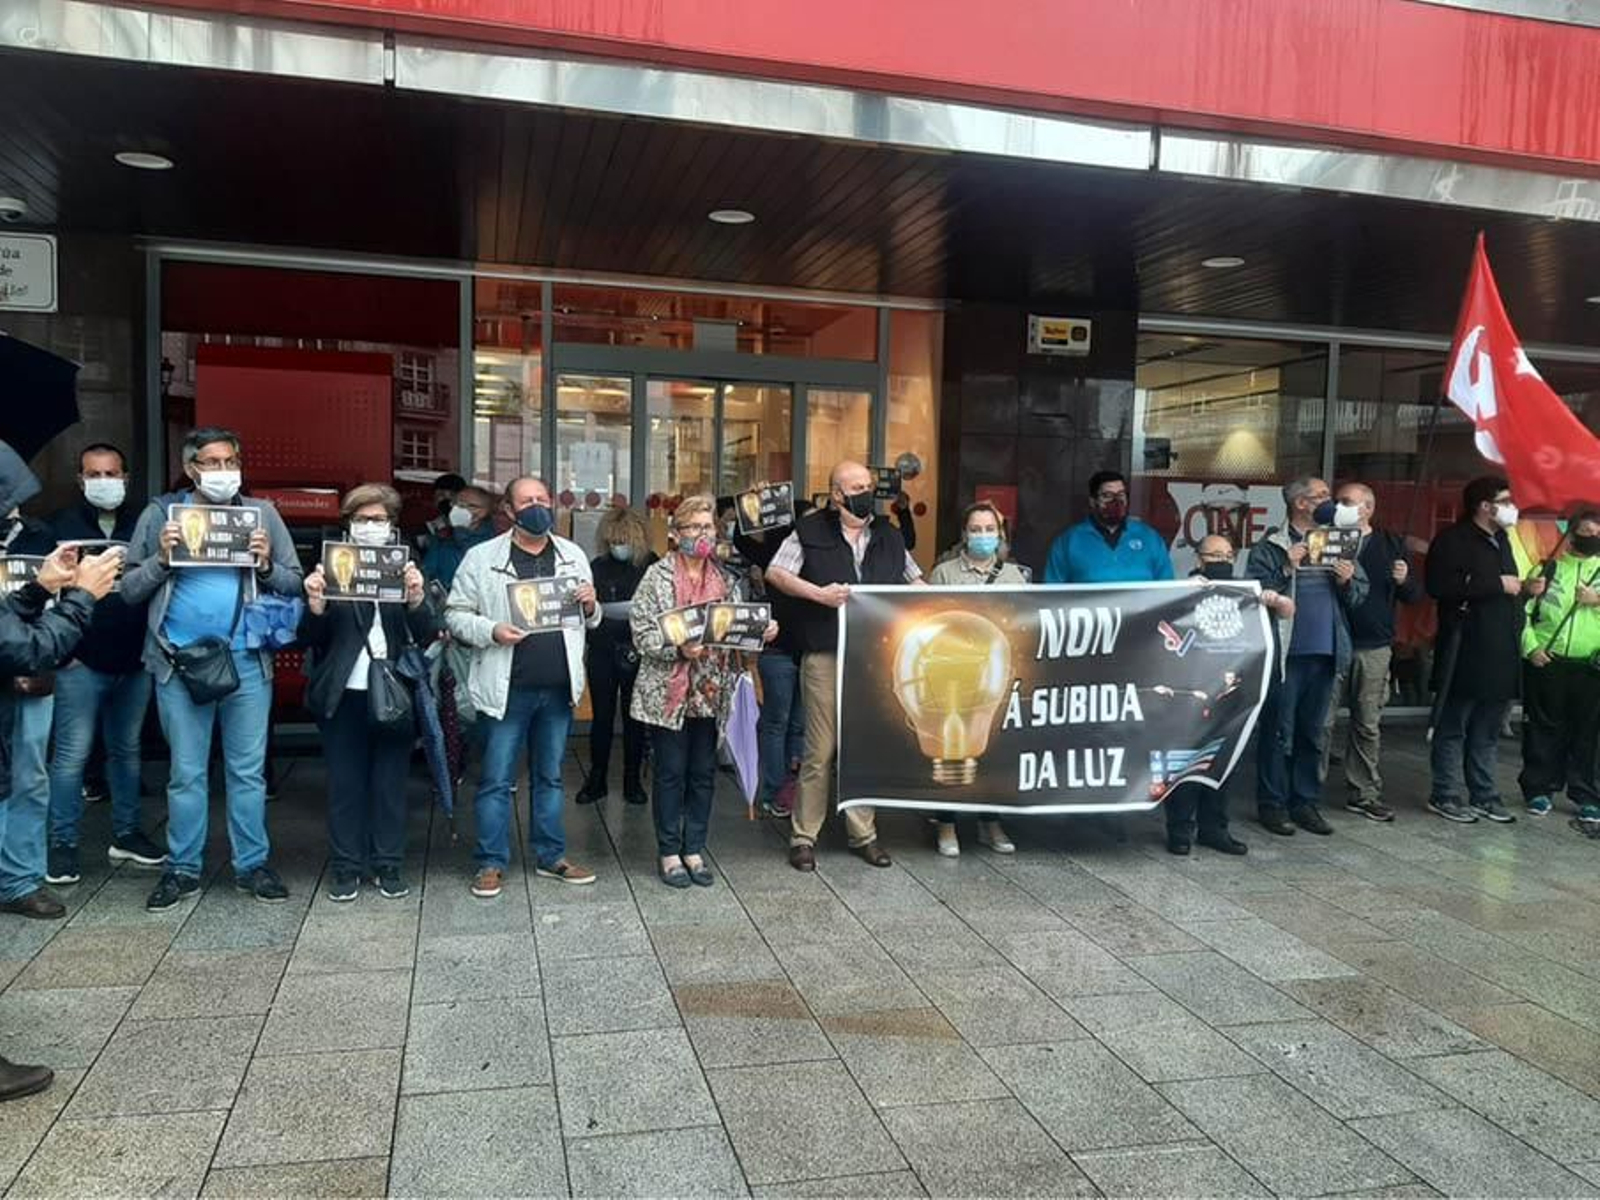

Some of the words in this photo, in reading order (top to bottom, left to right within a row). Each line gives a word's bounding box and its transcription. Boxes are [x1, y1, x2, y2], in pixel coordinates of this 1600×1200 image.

[1036, 607, 1122, 659] NON
[1002, 680, 1023, 730] Á
[1031, 683, 1144, 727] SUBIDA
[1018, 751, 1058, 791] DA
[1067, 747, 1127, 788] LUZ
